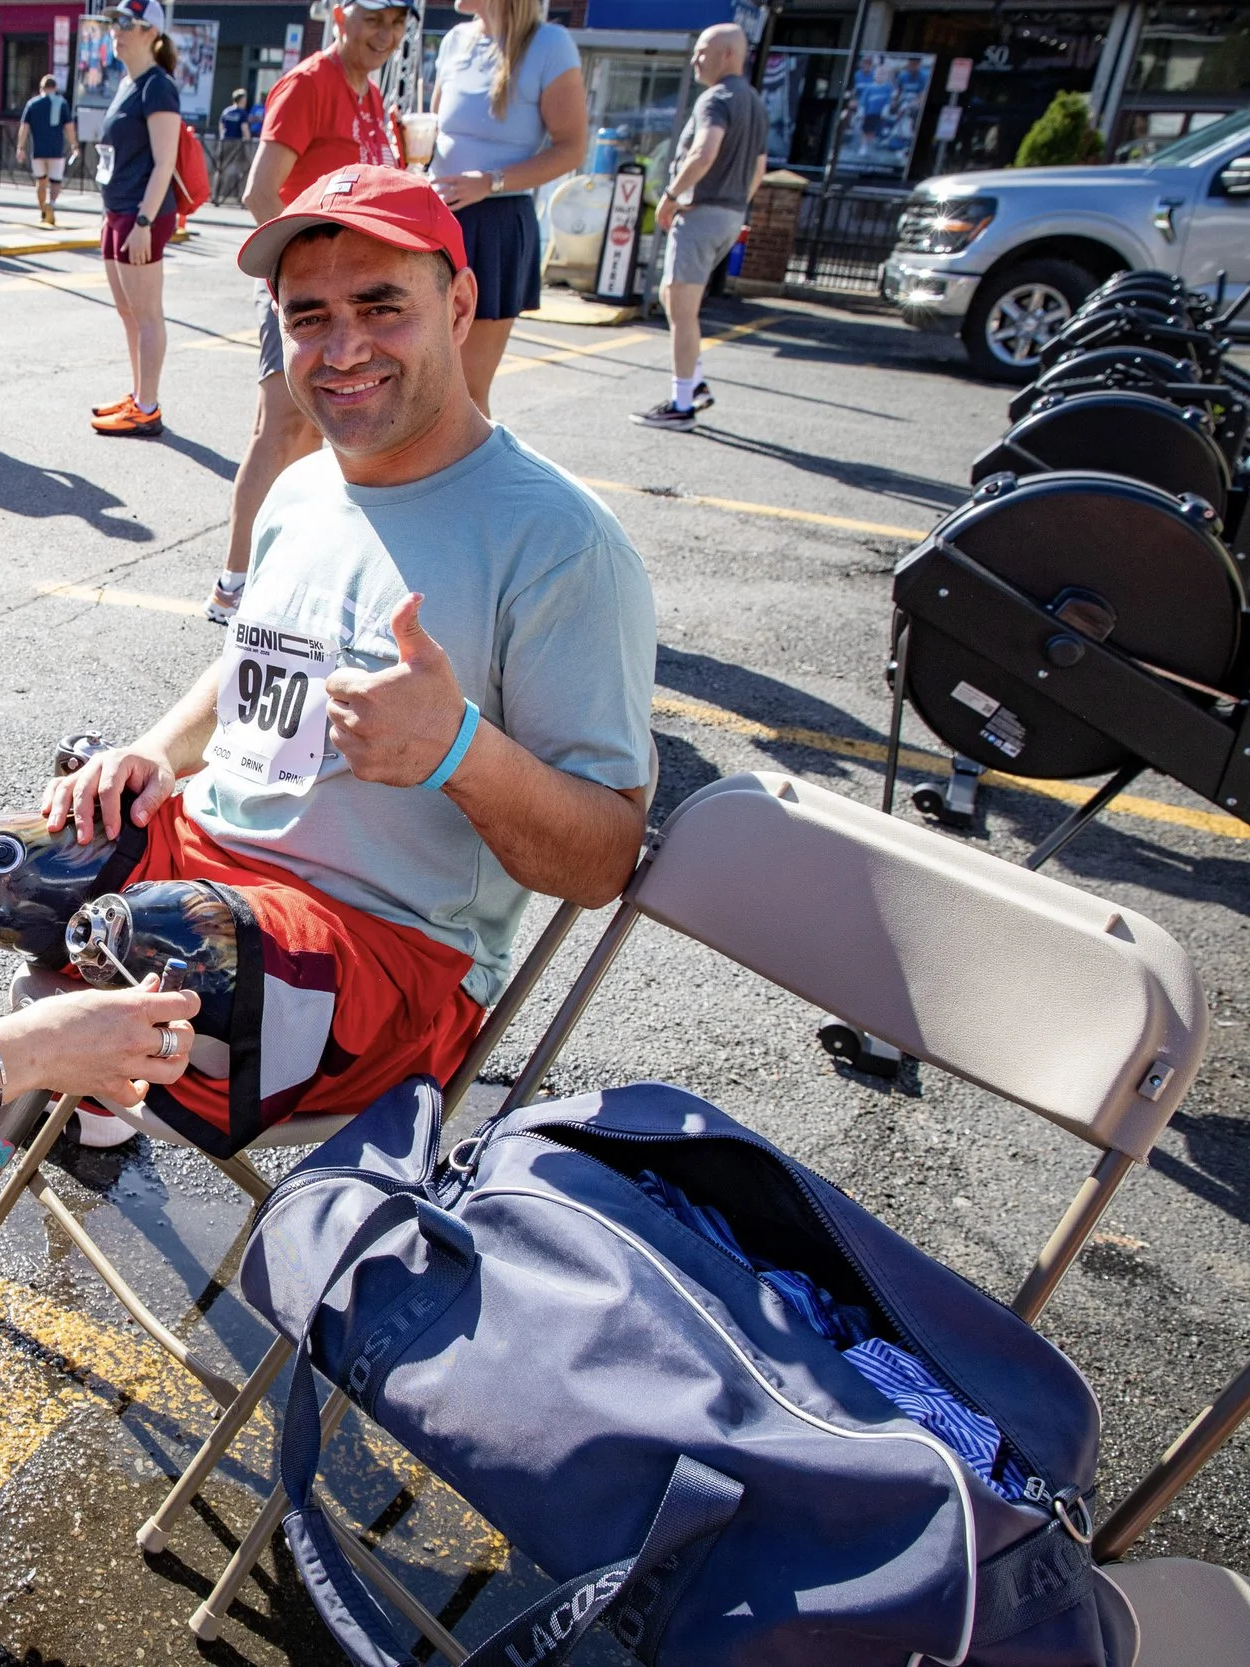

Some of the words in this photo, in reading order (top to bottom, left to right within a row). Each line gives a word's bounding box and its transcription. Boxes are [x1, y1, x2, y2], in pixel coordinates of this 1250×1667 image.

[236, 623, 310, 659] BIONIC
[237, 659, 309, 740] 950
[213, 746, 232, 760] FOOD
[241, 756, 264, 773] DRINK
[348, 1288, 437, 1393] OSTE
[504, 1566, 633, 1667] LACOS
